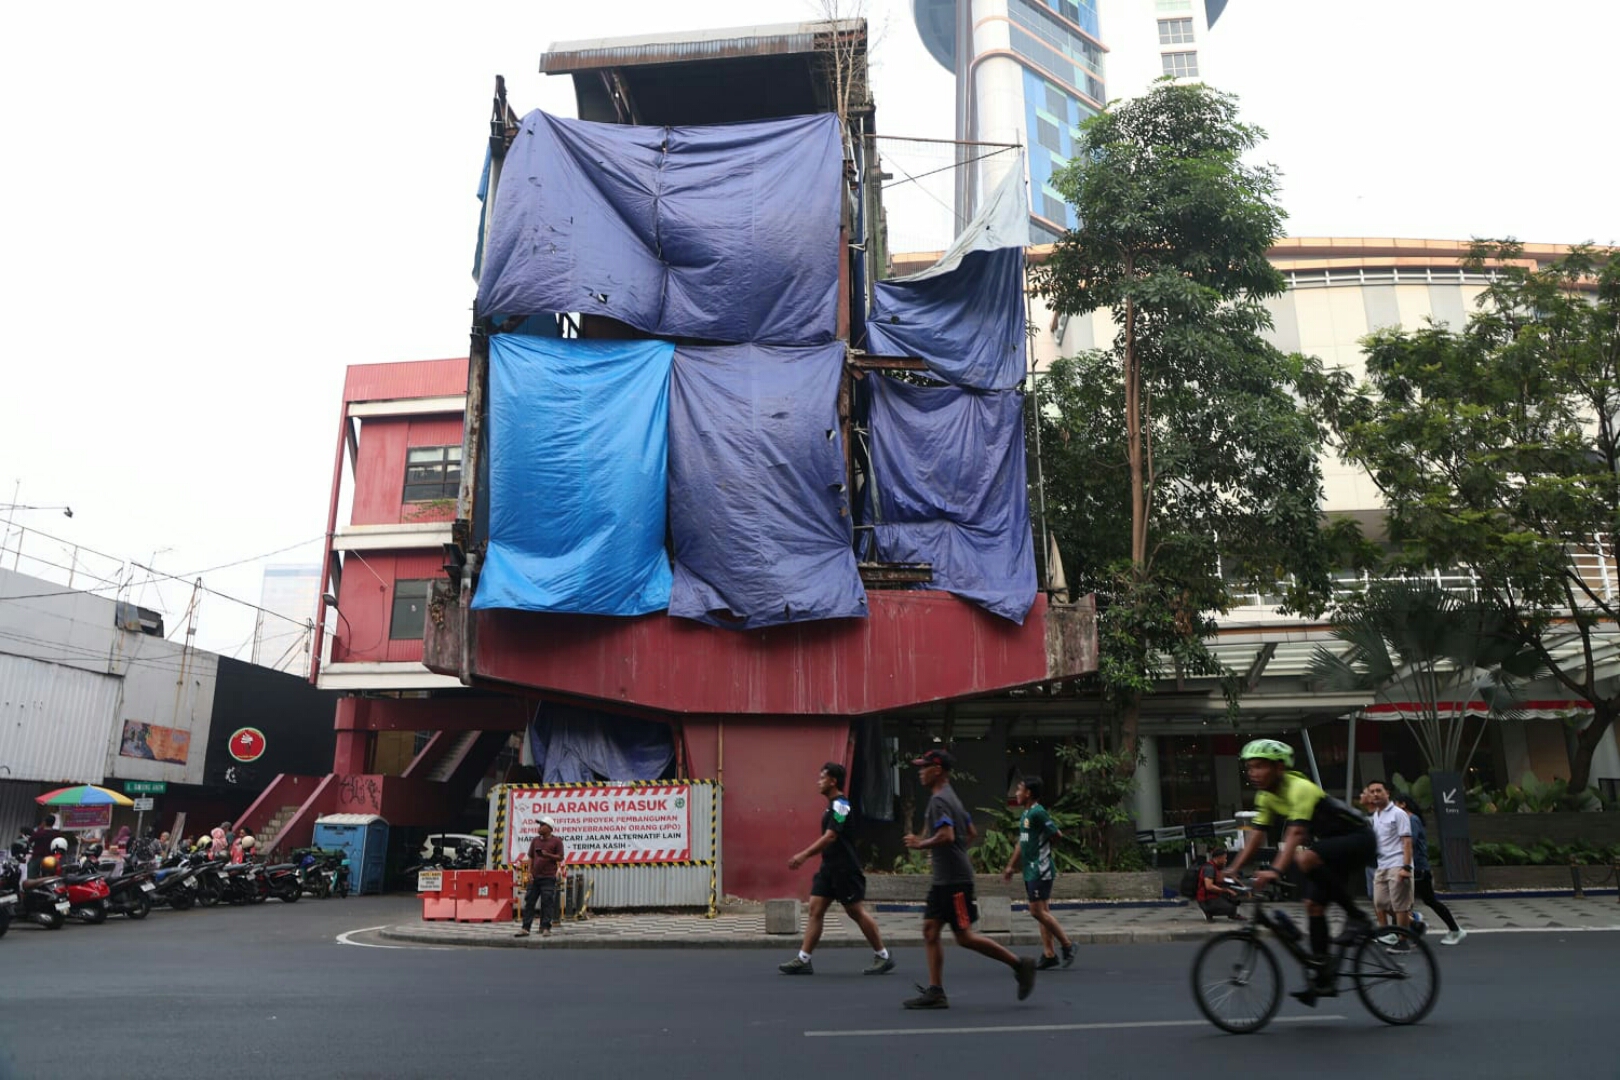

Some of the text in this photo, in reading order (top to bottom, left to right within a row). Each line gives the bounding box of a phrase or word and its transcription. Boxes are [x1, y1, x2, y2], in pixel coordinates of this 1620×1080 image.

[532, 799, 667, 814] DILARANG MASUK
[562, 825, 626, 833] PENYEBRANGAN
[629, 824, 657, 832] ORANG
[659, 823, 681, 832] (JPO)
